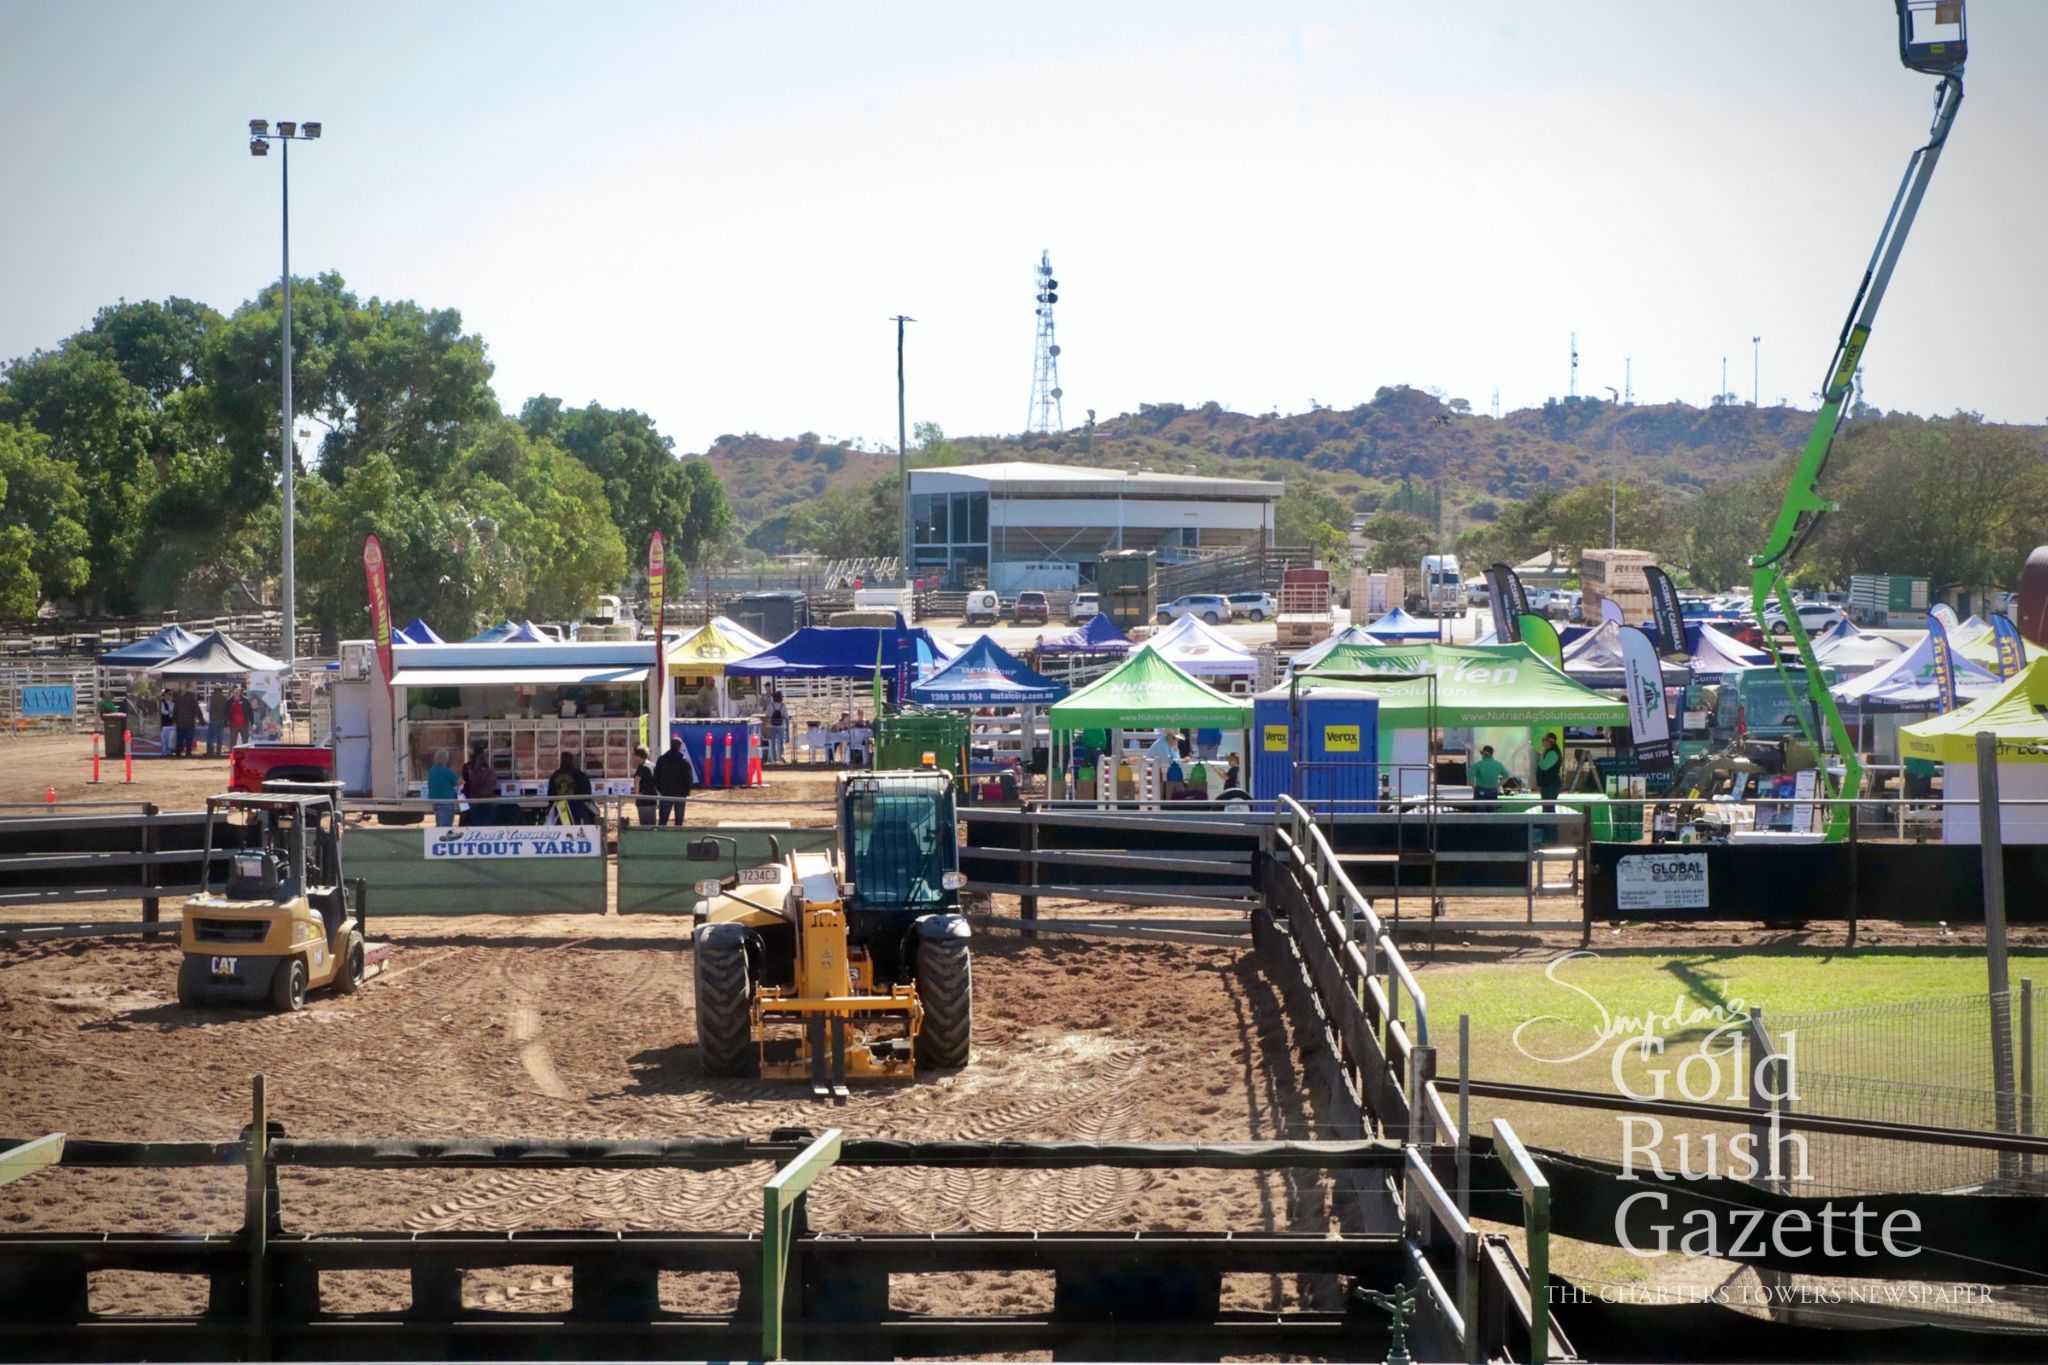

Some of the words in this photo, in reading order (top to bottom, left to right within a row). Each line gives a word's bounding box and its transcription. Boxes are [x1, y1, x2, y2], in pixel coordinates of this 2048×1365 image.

[1614, 564, 1644, 573] REYE
[1507, 574, 1521, 610] SECURITY
[1658, 575, 1673, 612] SECURITY
[1667, 612, 1683, 651] CAMERAS
[961, 667, 1017, 676] METALCORP
[931, 693, 949, 701] 1300
[951, 693, 966, 701] 306
[968, 693, 983, 701] 204
[990, 691, 1054, 702] metalcorp.com.au
[1385, 686, 1478, 698] Solutions
[1119, 713, 1237, 722] www.NutrienAgSolutions.com.au
[1461, 710, 1624, 722] www.NutrienAgSolutions.com.au
[1265, 732, 1287, 741] Verax
[1326, 732, 1357, 742] Verax
[463, 829, 504, 842] Noel
[506, 829, 562, 842] Toomey
[432, 842, 523, 857] CUTOUT
[532, 841, 592, 855] YARD
[1652, 862, 1704, 874] GLOBAL
[742, 870, 778, 882] 7234C3
[1652, 874, 1677, 882] WELDING
[1677, 873, 1704, 882] SUPPLIES
[211, 957, 238, 975] CAT
